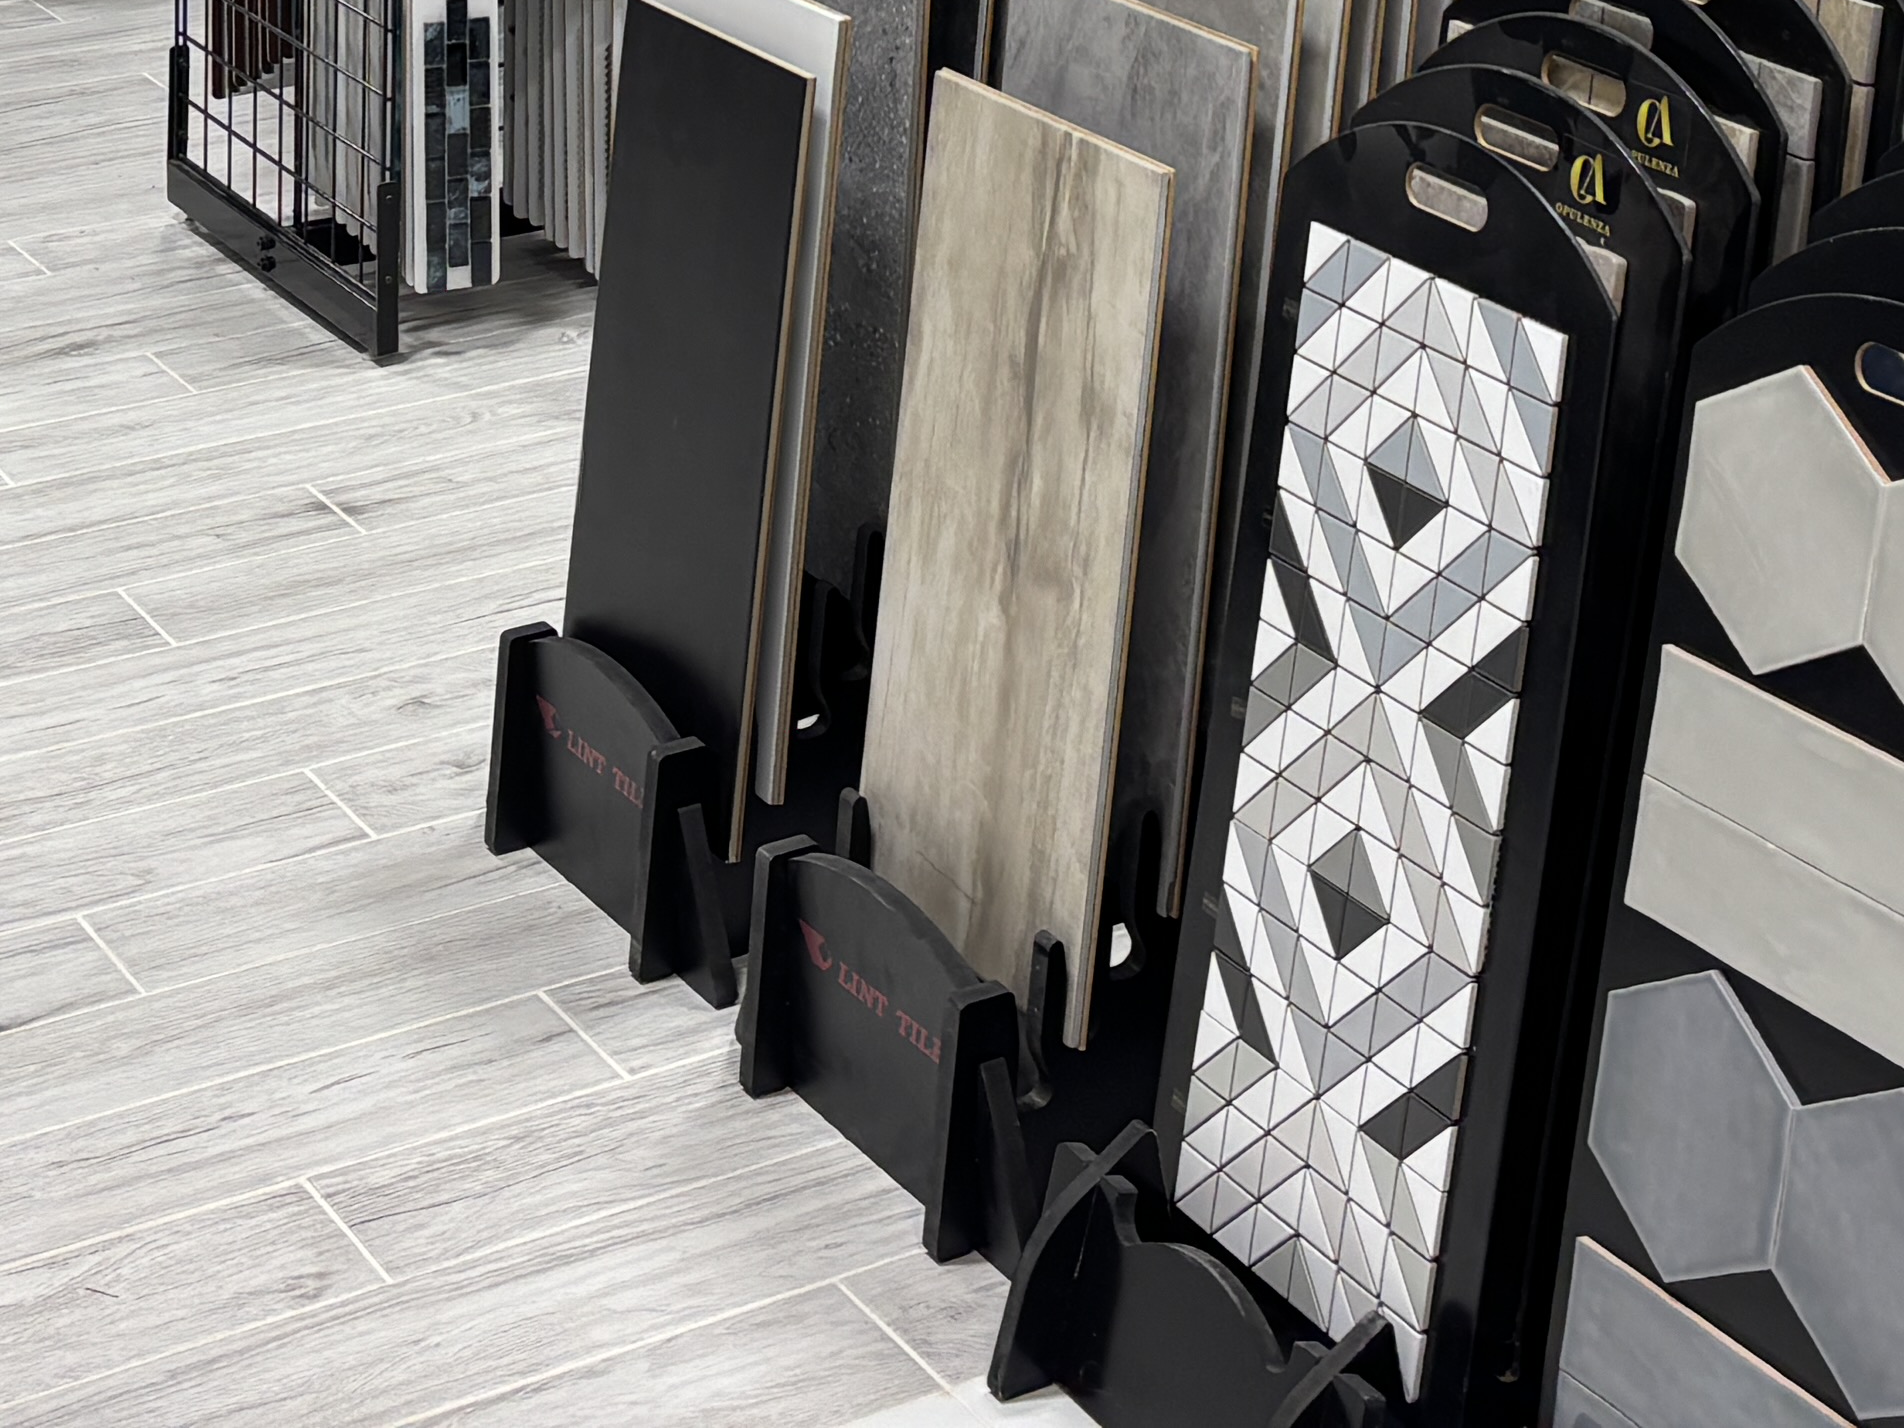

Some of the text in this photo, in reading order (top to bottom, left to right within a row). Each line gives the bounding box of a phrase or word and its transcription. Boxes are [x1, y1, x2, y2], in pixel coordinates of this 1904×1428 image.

[1631, 150, 1680, 178] PULENZA
[1555, 202, 1611, 237] OPULENZA
[566, 728, 606, 776] LINT
[837, 961, 889, 1018] LINT
